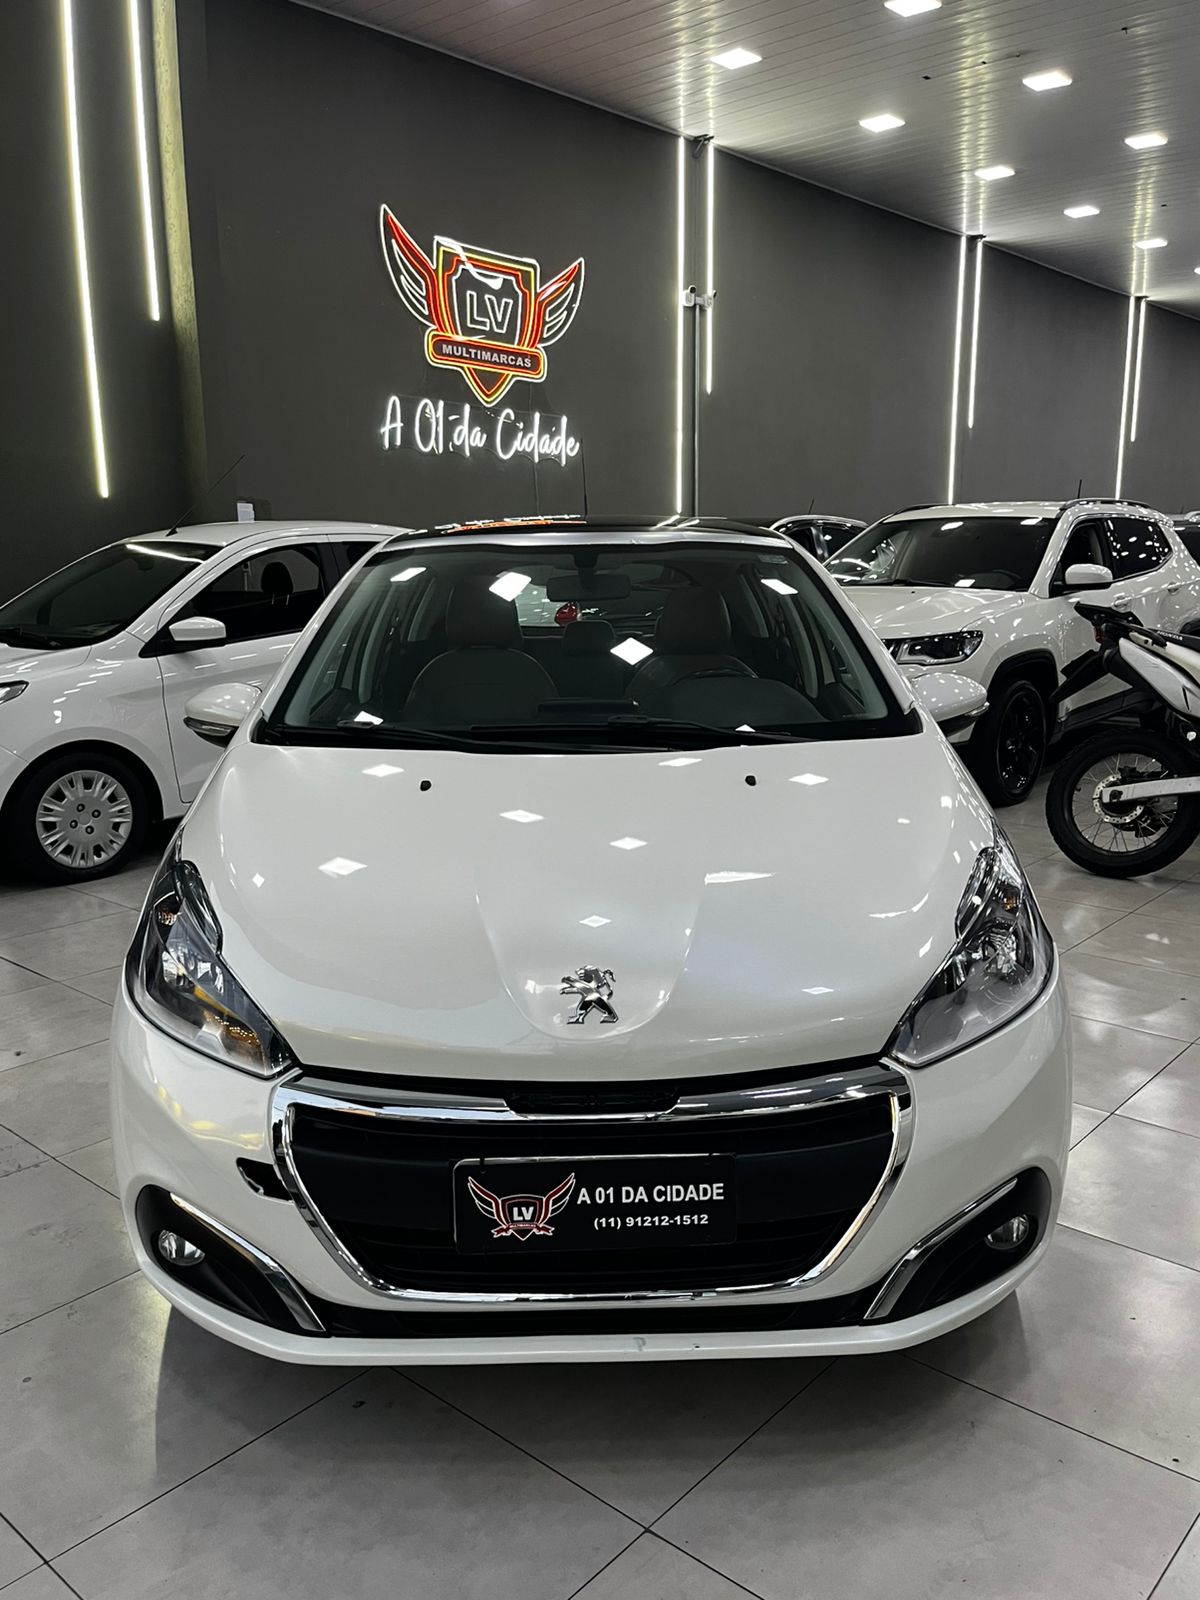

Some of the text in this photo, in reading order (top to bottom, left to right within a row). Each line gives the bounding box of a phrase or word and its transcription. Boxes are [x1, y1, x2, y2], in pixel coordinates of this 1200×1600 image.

[466, 290, 513, 333] LV
[442, 343, 532, 369] MULTIMARCAS
[379, 395, 404, 450] A
[453, 403, 487, 457] da
[496, 408, 580, 467] Cidade
[577, 1183, 724, 1204] A 01 DA CIDADE
[512, 1206, 534, 1221] LV
[594, 1214, 709, 1230] (11) 91212-1512
